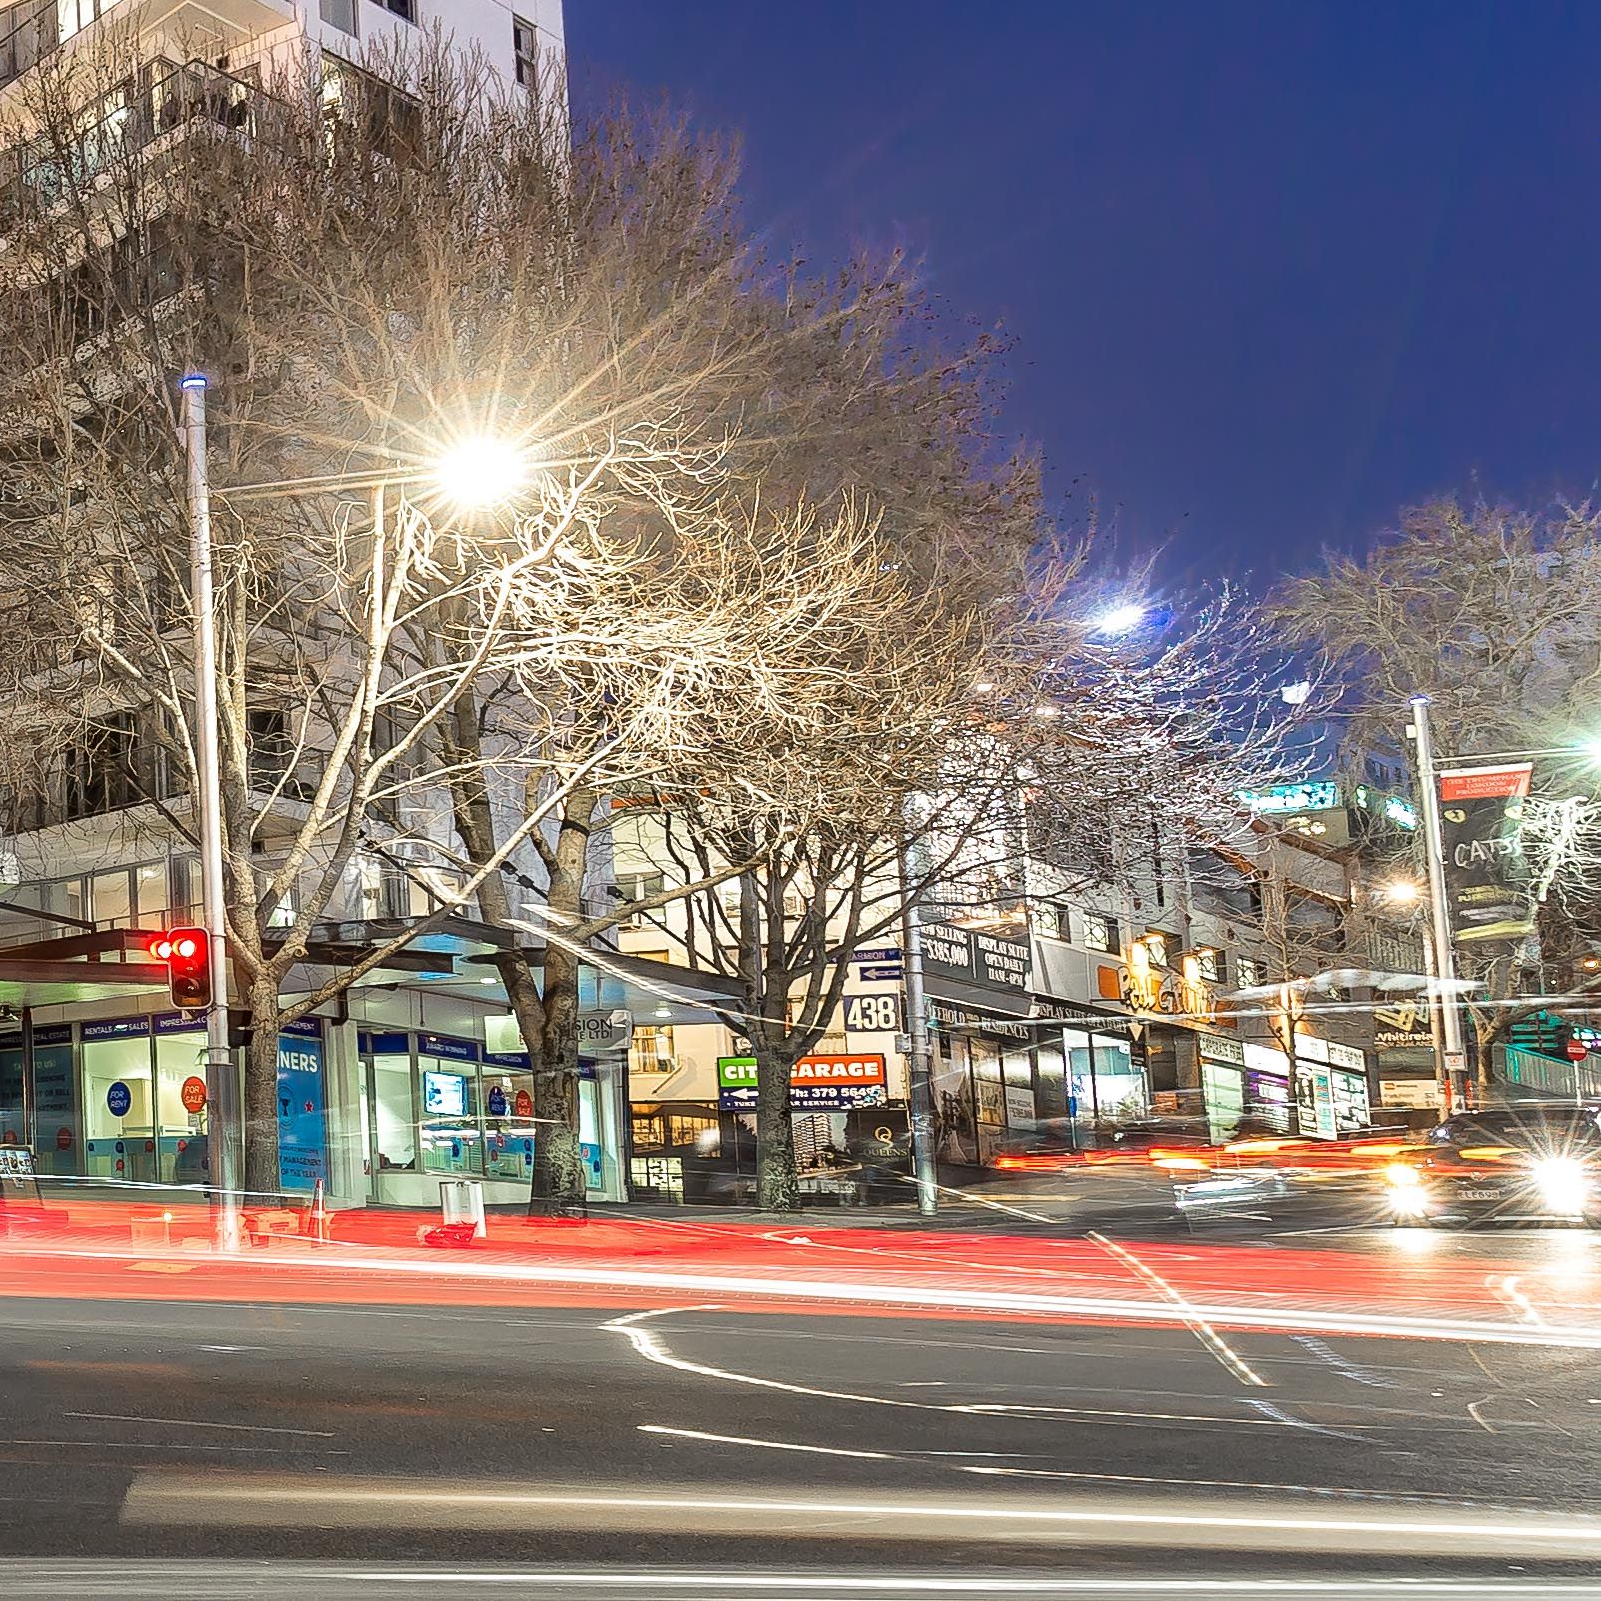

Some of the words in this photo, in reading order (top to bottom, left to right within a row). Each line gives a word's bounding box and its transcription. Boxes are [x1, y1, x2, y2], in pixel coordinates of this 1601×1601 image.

[936, 925, 968, 945] SELLING
[927, 937, 969, 967] $385,000
[978, 936, 1007, 956] DISPLAY
[1008, 944, 1029, 960] SUITE
[984, 952, 1003, 969] OPEN
[1004, 956, 1025, 973] DAILY
[847, 996, 896, 1030] 438
[84, 1025, 112, 1036] RENTALS
[128, 1021, 149, 1031] SALES
[982, 1016, 1029, 1039] RESIDENCES
[277, 1050, 318, 1073] NERS
[724, 1065, 759, 1080] CIT
[109, 1090, 124, 1099] FOR
[184, 1085, 200, 1095] FOR
[812, 1088, 838, 1098] 379
[109, 1099, 128, 1109] RENT
[184, 1095, 203, 1105] SALE
[864, 1148, 907, 1158] QUEENS
